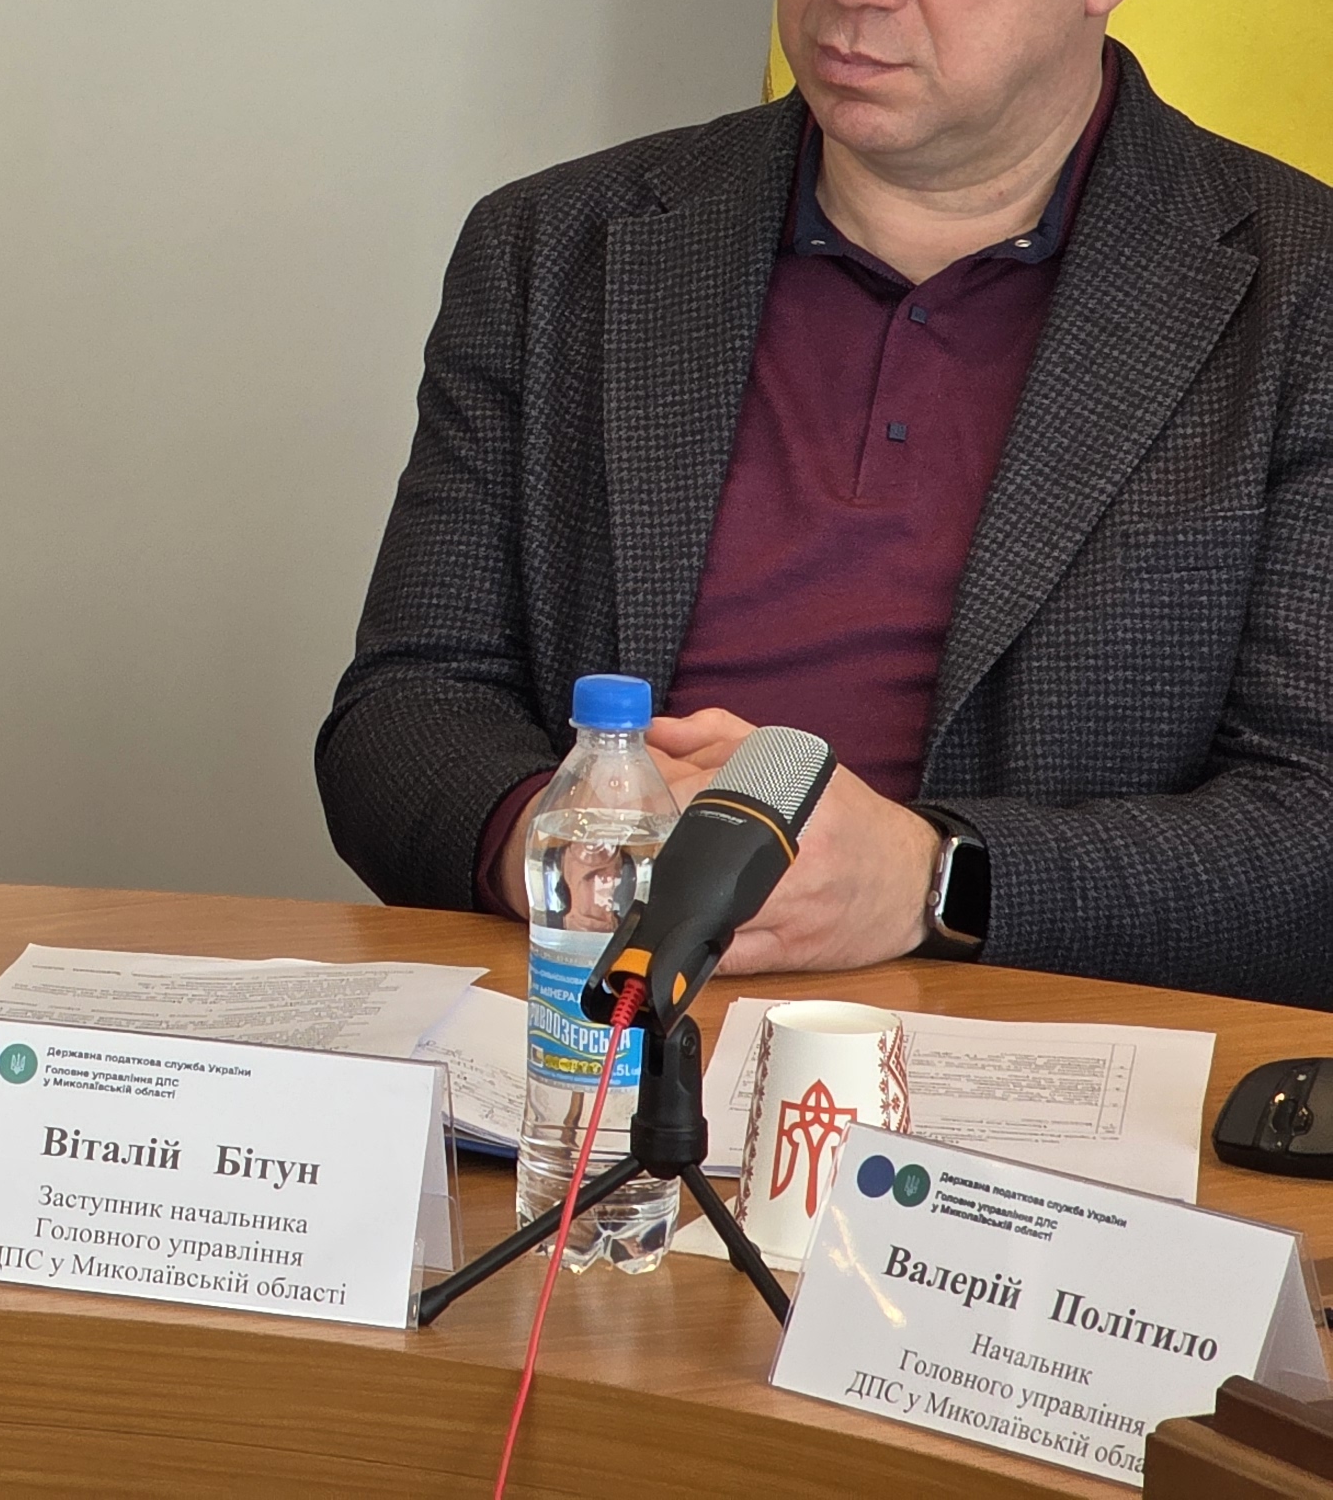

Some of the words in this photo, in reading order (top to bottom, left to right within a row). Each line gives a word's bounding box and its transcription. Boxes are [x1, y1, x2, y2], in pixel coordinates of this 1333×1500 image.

[44, 1064, 90, 1078] Головне
[91, 1071, 153, 1085] управління
[154, 1076, 180, 1088] ДПС
[46, 1046, 103, 1061] Державна
[104, 1054, 162, 1068] податкова
[163, 1060, 206, 1073] служба
[207, 1063, 252, 1078] України
[52, 1077, 132, 1095] Миколаївській
[134, 1086, 176, 1100] області
[39, 1125, 183, 1171] Віталій
[212, 1144, 321, 1190] Бітун
[38, 1184, 164, 1219] Заступник
[170, 1205, 308, 1235] начальника
[34, 1217, 161, 1251] Головного
[166, 1237, 304, 1268] управління
[48, 1257, 65, 1278] у
[70, 1253, 249, 1295] Миколаївській
[256, 1276, 347, 1306] області
[880, 1243, 1023, 1311] Валерій
[1047, 1288, 1218, 1362] Політило
[970, 1332, 1094, 1386] Начальник
[898, 1348, 1014, 1400] Головного
[1016, 1387, 1149, 1441] управління
[844, 1370, 904, 1404] ДПС
[902, 1392, 922, 1414] у
[923, 1391, 1091, 1458] Миколаївській
[1094, 1443, 1144, 1473] обла
